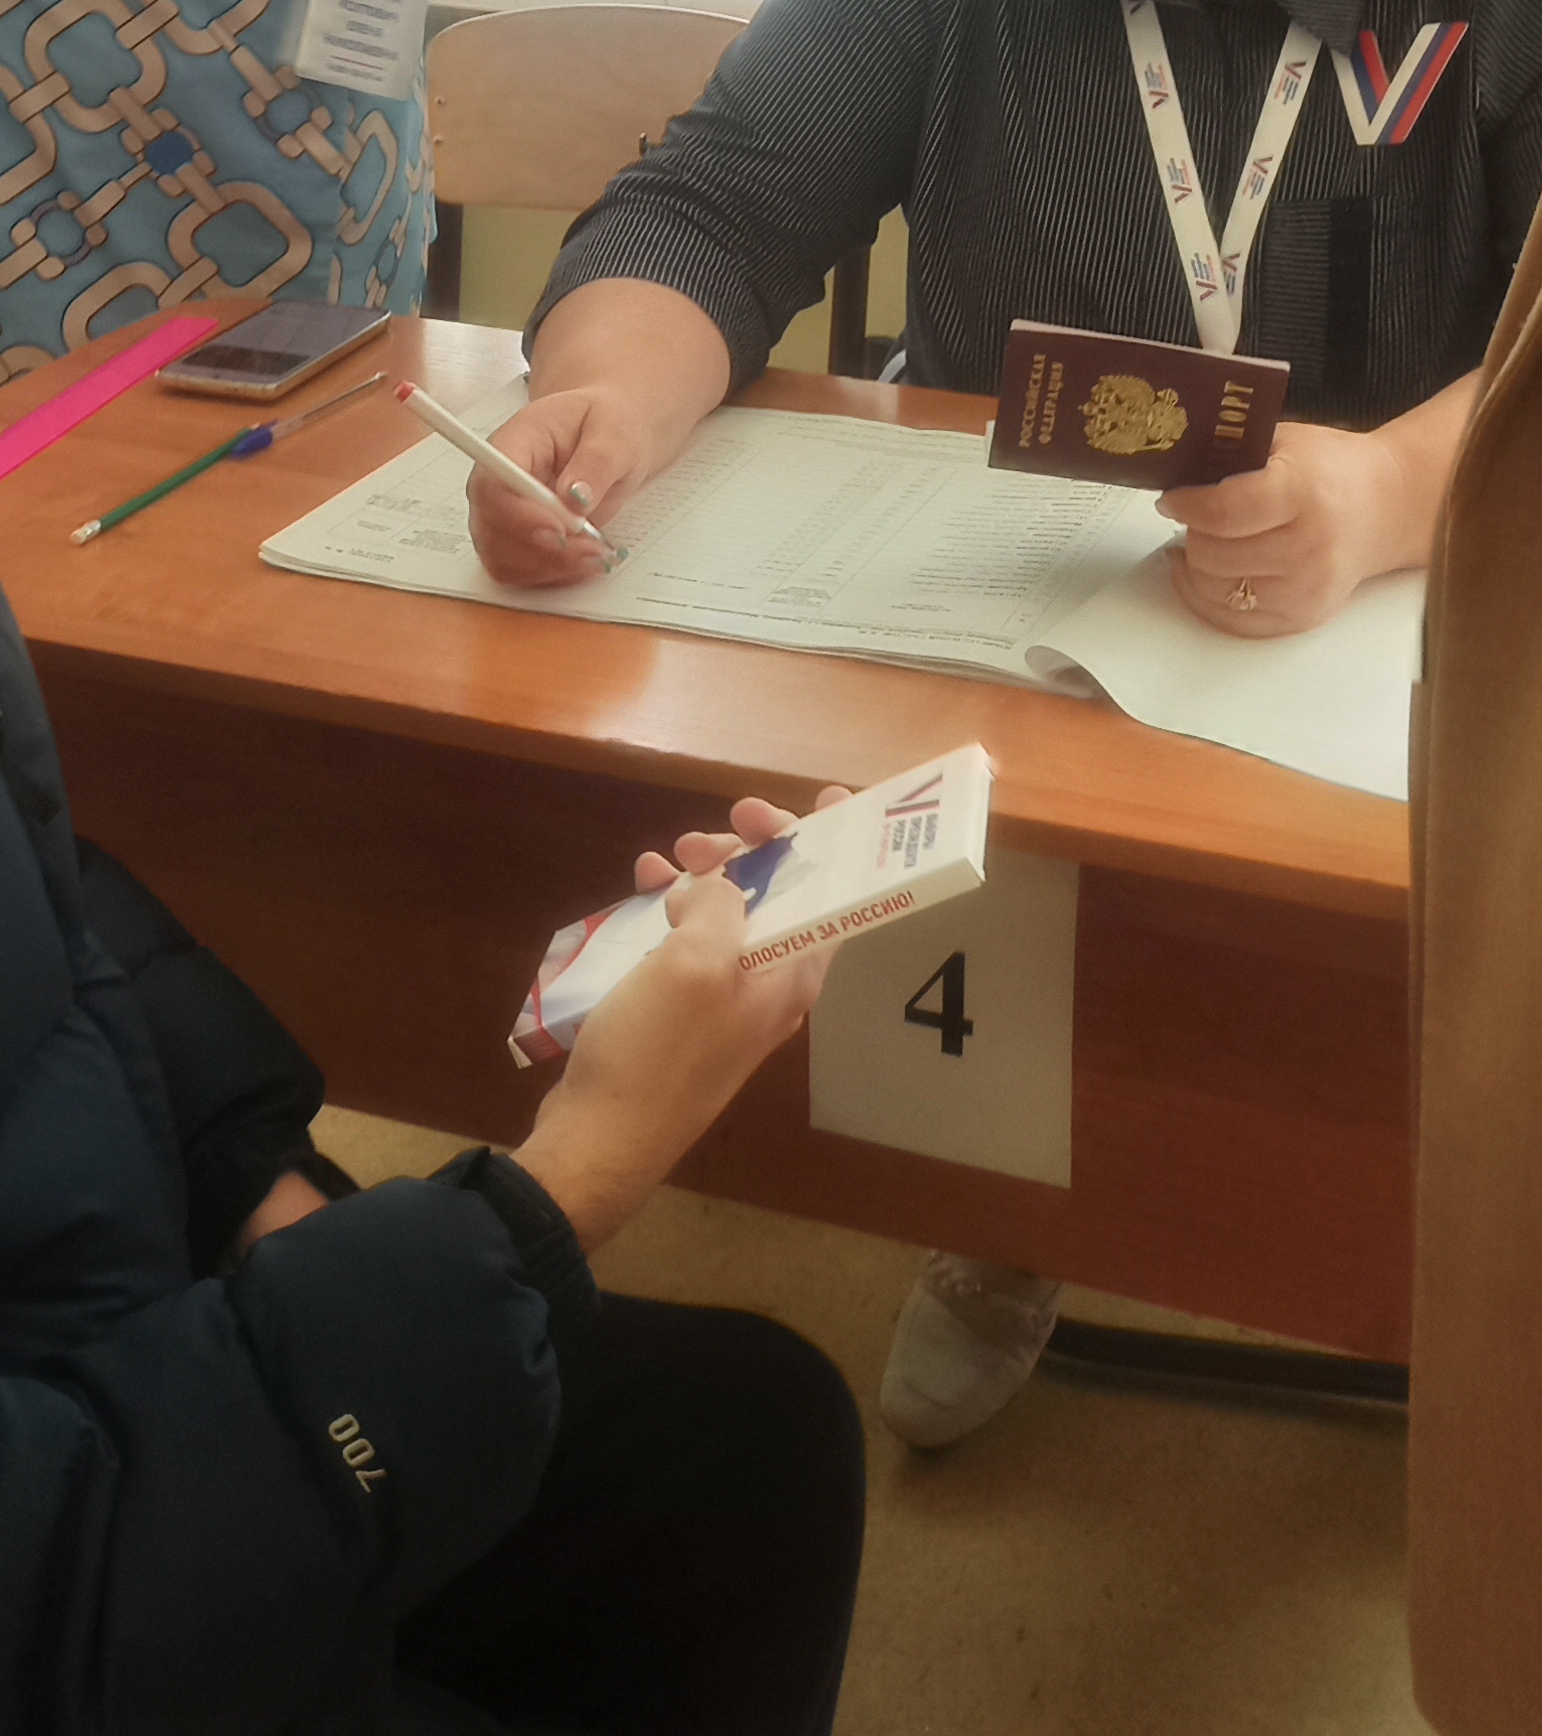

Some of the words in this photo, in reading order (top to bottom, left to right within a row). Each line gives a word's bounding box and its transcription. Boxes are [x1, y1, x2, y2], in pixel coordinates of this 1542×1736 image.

[1215, 380, 1254, 439] ПОРТ
[738, 930, 816, 971] ОЛОСУЕМ
[816, 921, 840, 941] ЗА
[841, 890, 916, 932] РОССИЮ!
[904, 950, 973, 1057] 4
[328, 1413, 388, 1493] 700
